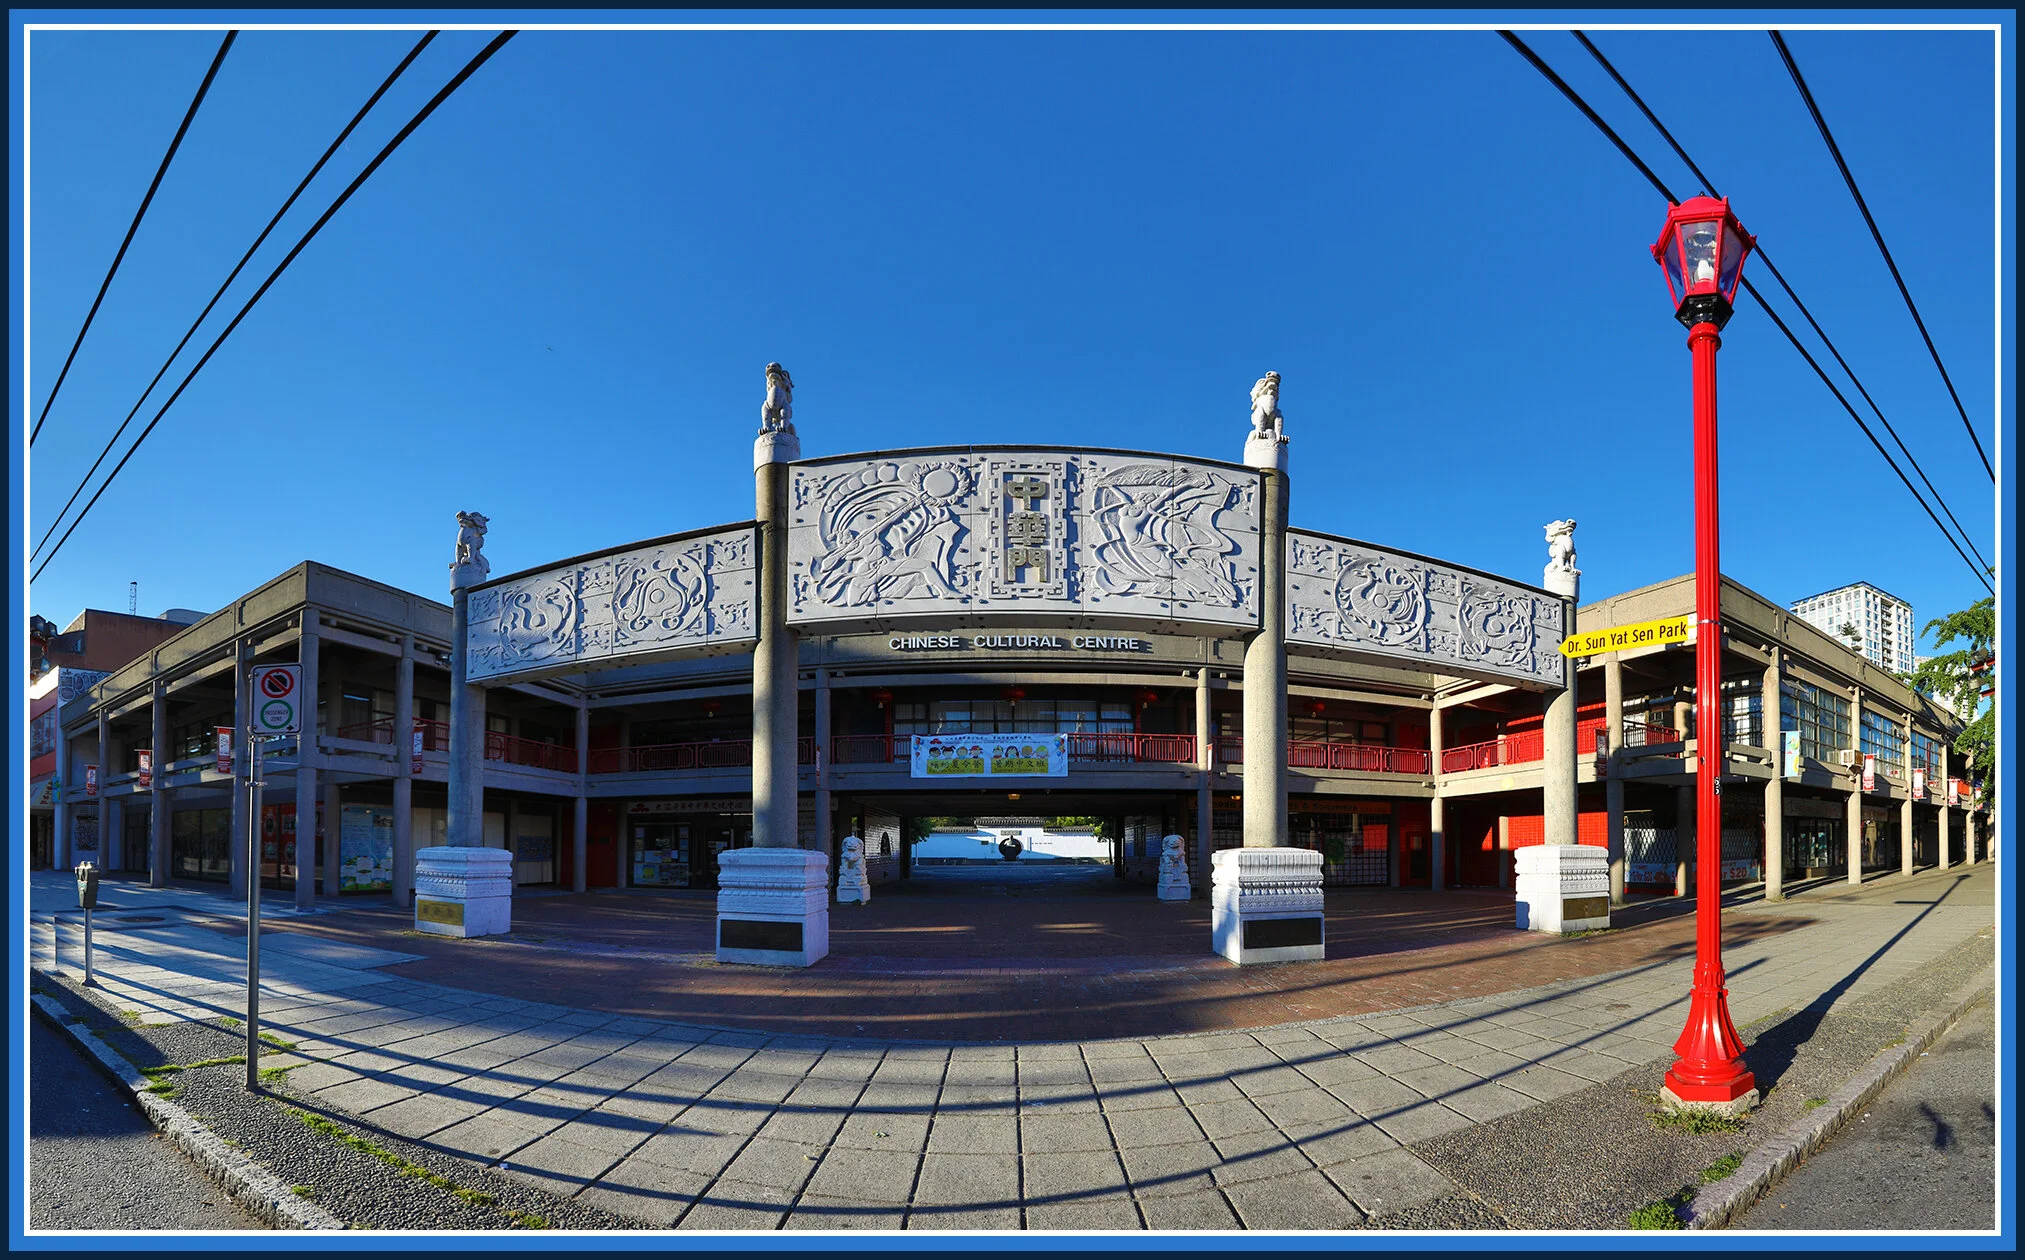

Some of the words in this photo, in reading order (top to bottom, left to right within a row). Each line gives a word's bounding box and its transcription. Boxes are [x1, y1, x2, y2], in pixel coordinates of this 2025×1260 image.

[888, 636, 960, 650] CHINESE
[973, 635, 1062, 648] CULTURAL
[1071, 636, 1139, 650] CENTRE
[1568, 640, 1582, 653] Dr.
[1586, 637, 1606, 650] Sun
[1610, 631, 1628, 646] Yat
[1632, 629, 1654, 642] Sen
[1659, 621, 1687, 639] Park
[1730, 867, 1747, 879] $20
